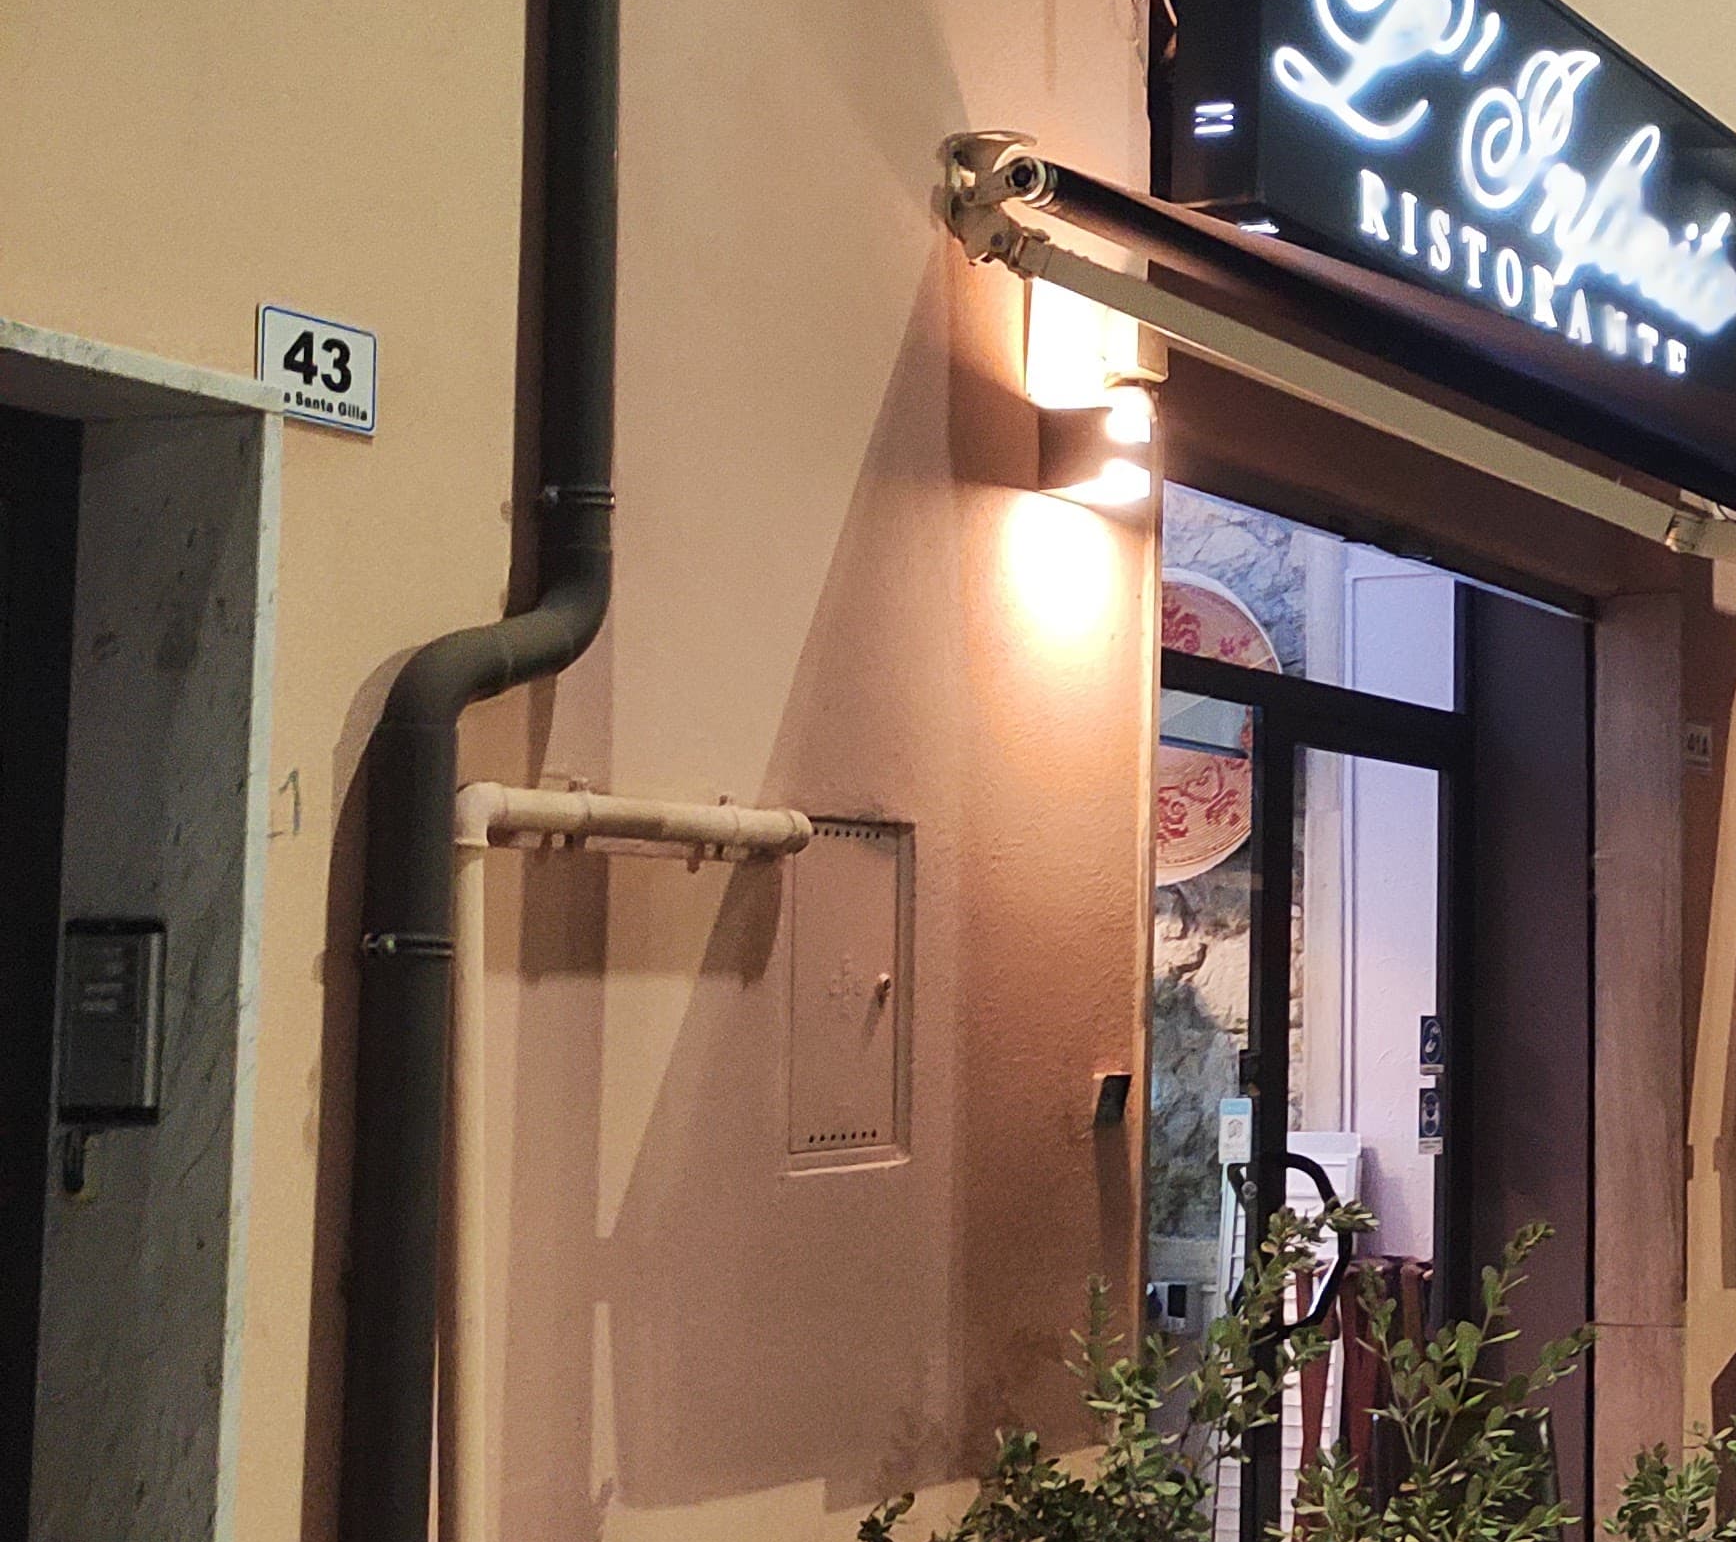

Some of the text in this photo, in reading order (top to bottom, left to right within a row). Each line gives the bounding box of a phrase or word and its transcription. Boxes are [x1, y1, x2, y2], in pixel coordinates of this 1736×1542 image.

[1359, 168, 1688, 375] RISTORANTE
[283, 330, 352, 394] 43
[295, 391, 334, 414] Santa
